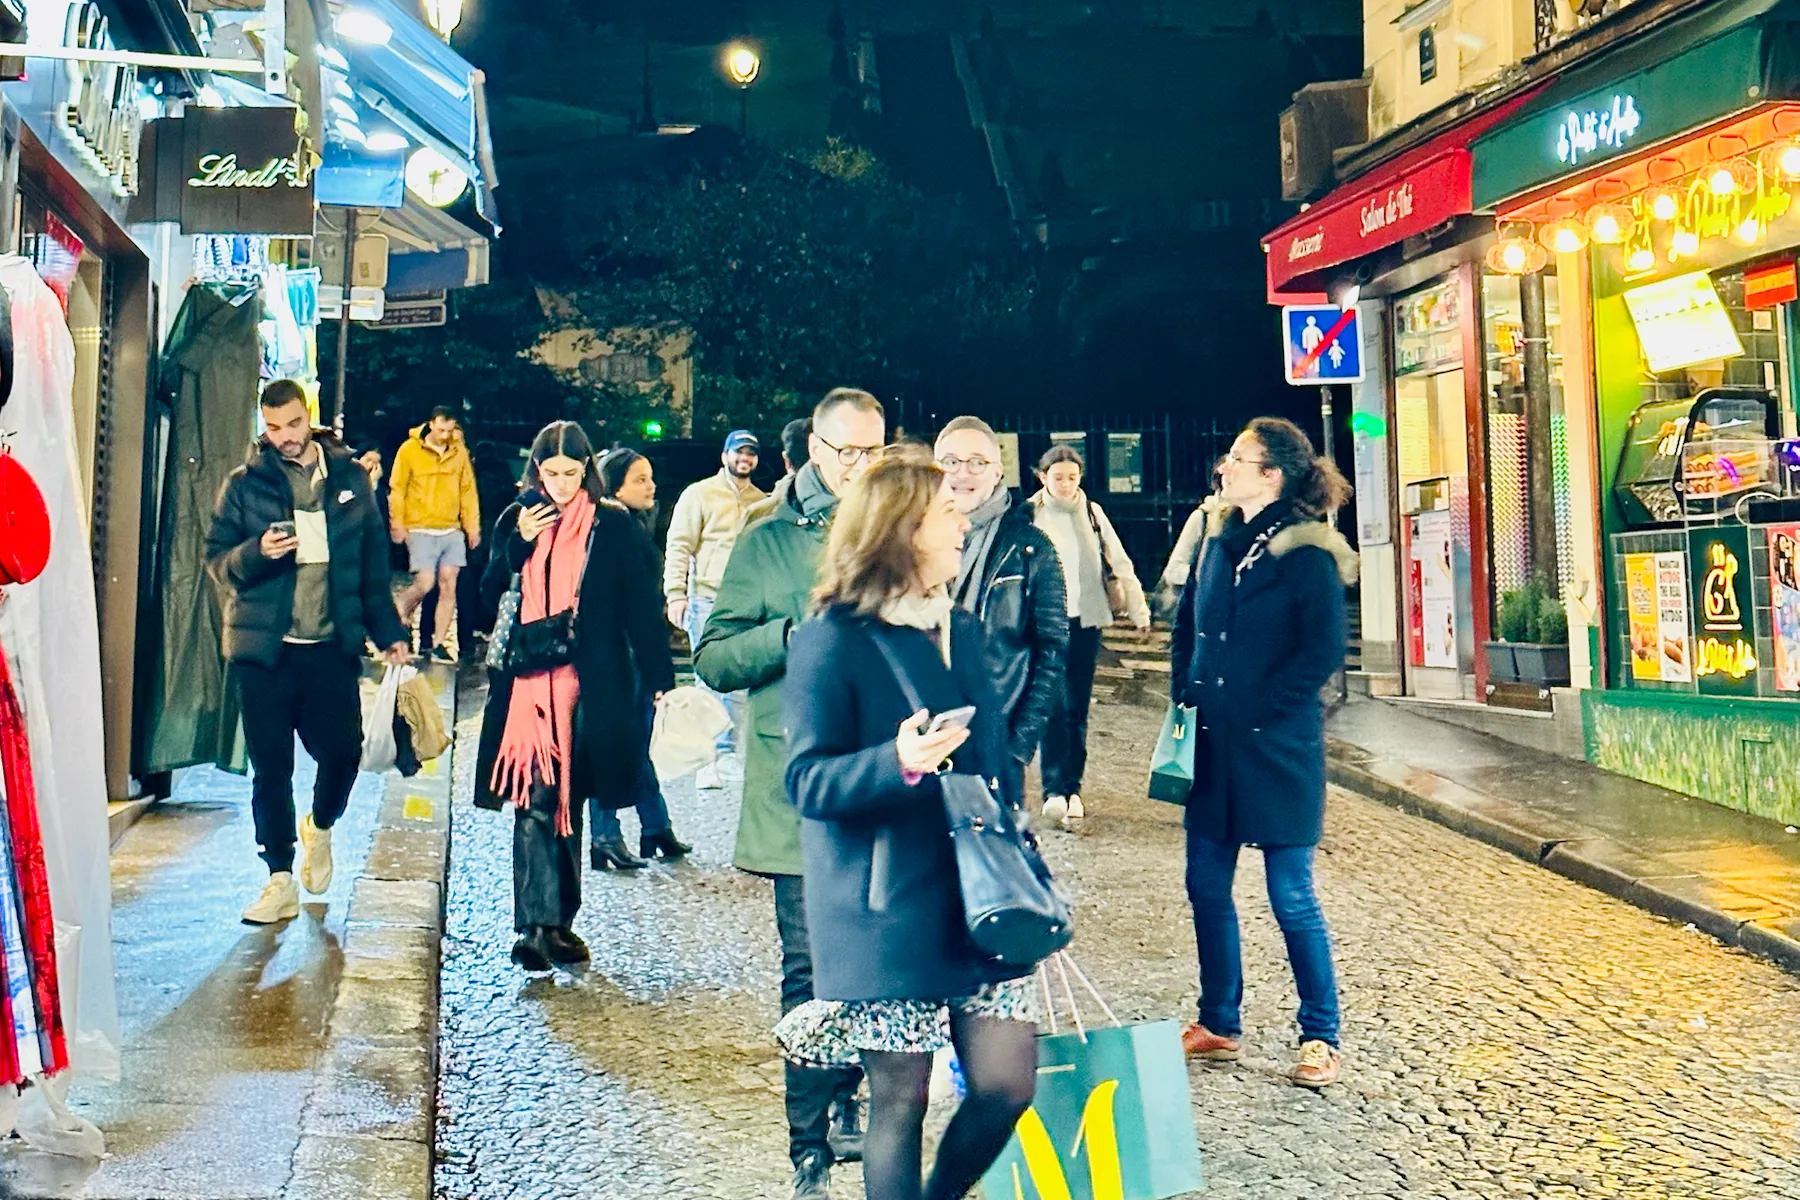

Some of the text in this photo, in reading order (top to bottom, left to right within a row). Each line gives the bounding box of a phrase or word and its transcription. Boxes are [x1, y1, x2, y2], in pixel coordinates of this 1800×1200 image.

[187, 153, 289, 189] Lindt
[1359, 198, 1385, 238] Salon
[1385, 190, 1397, 225] de
